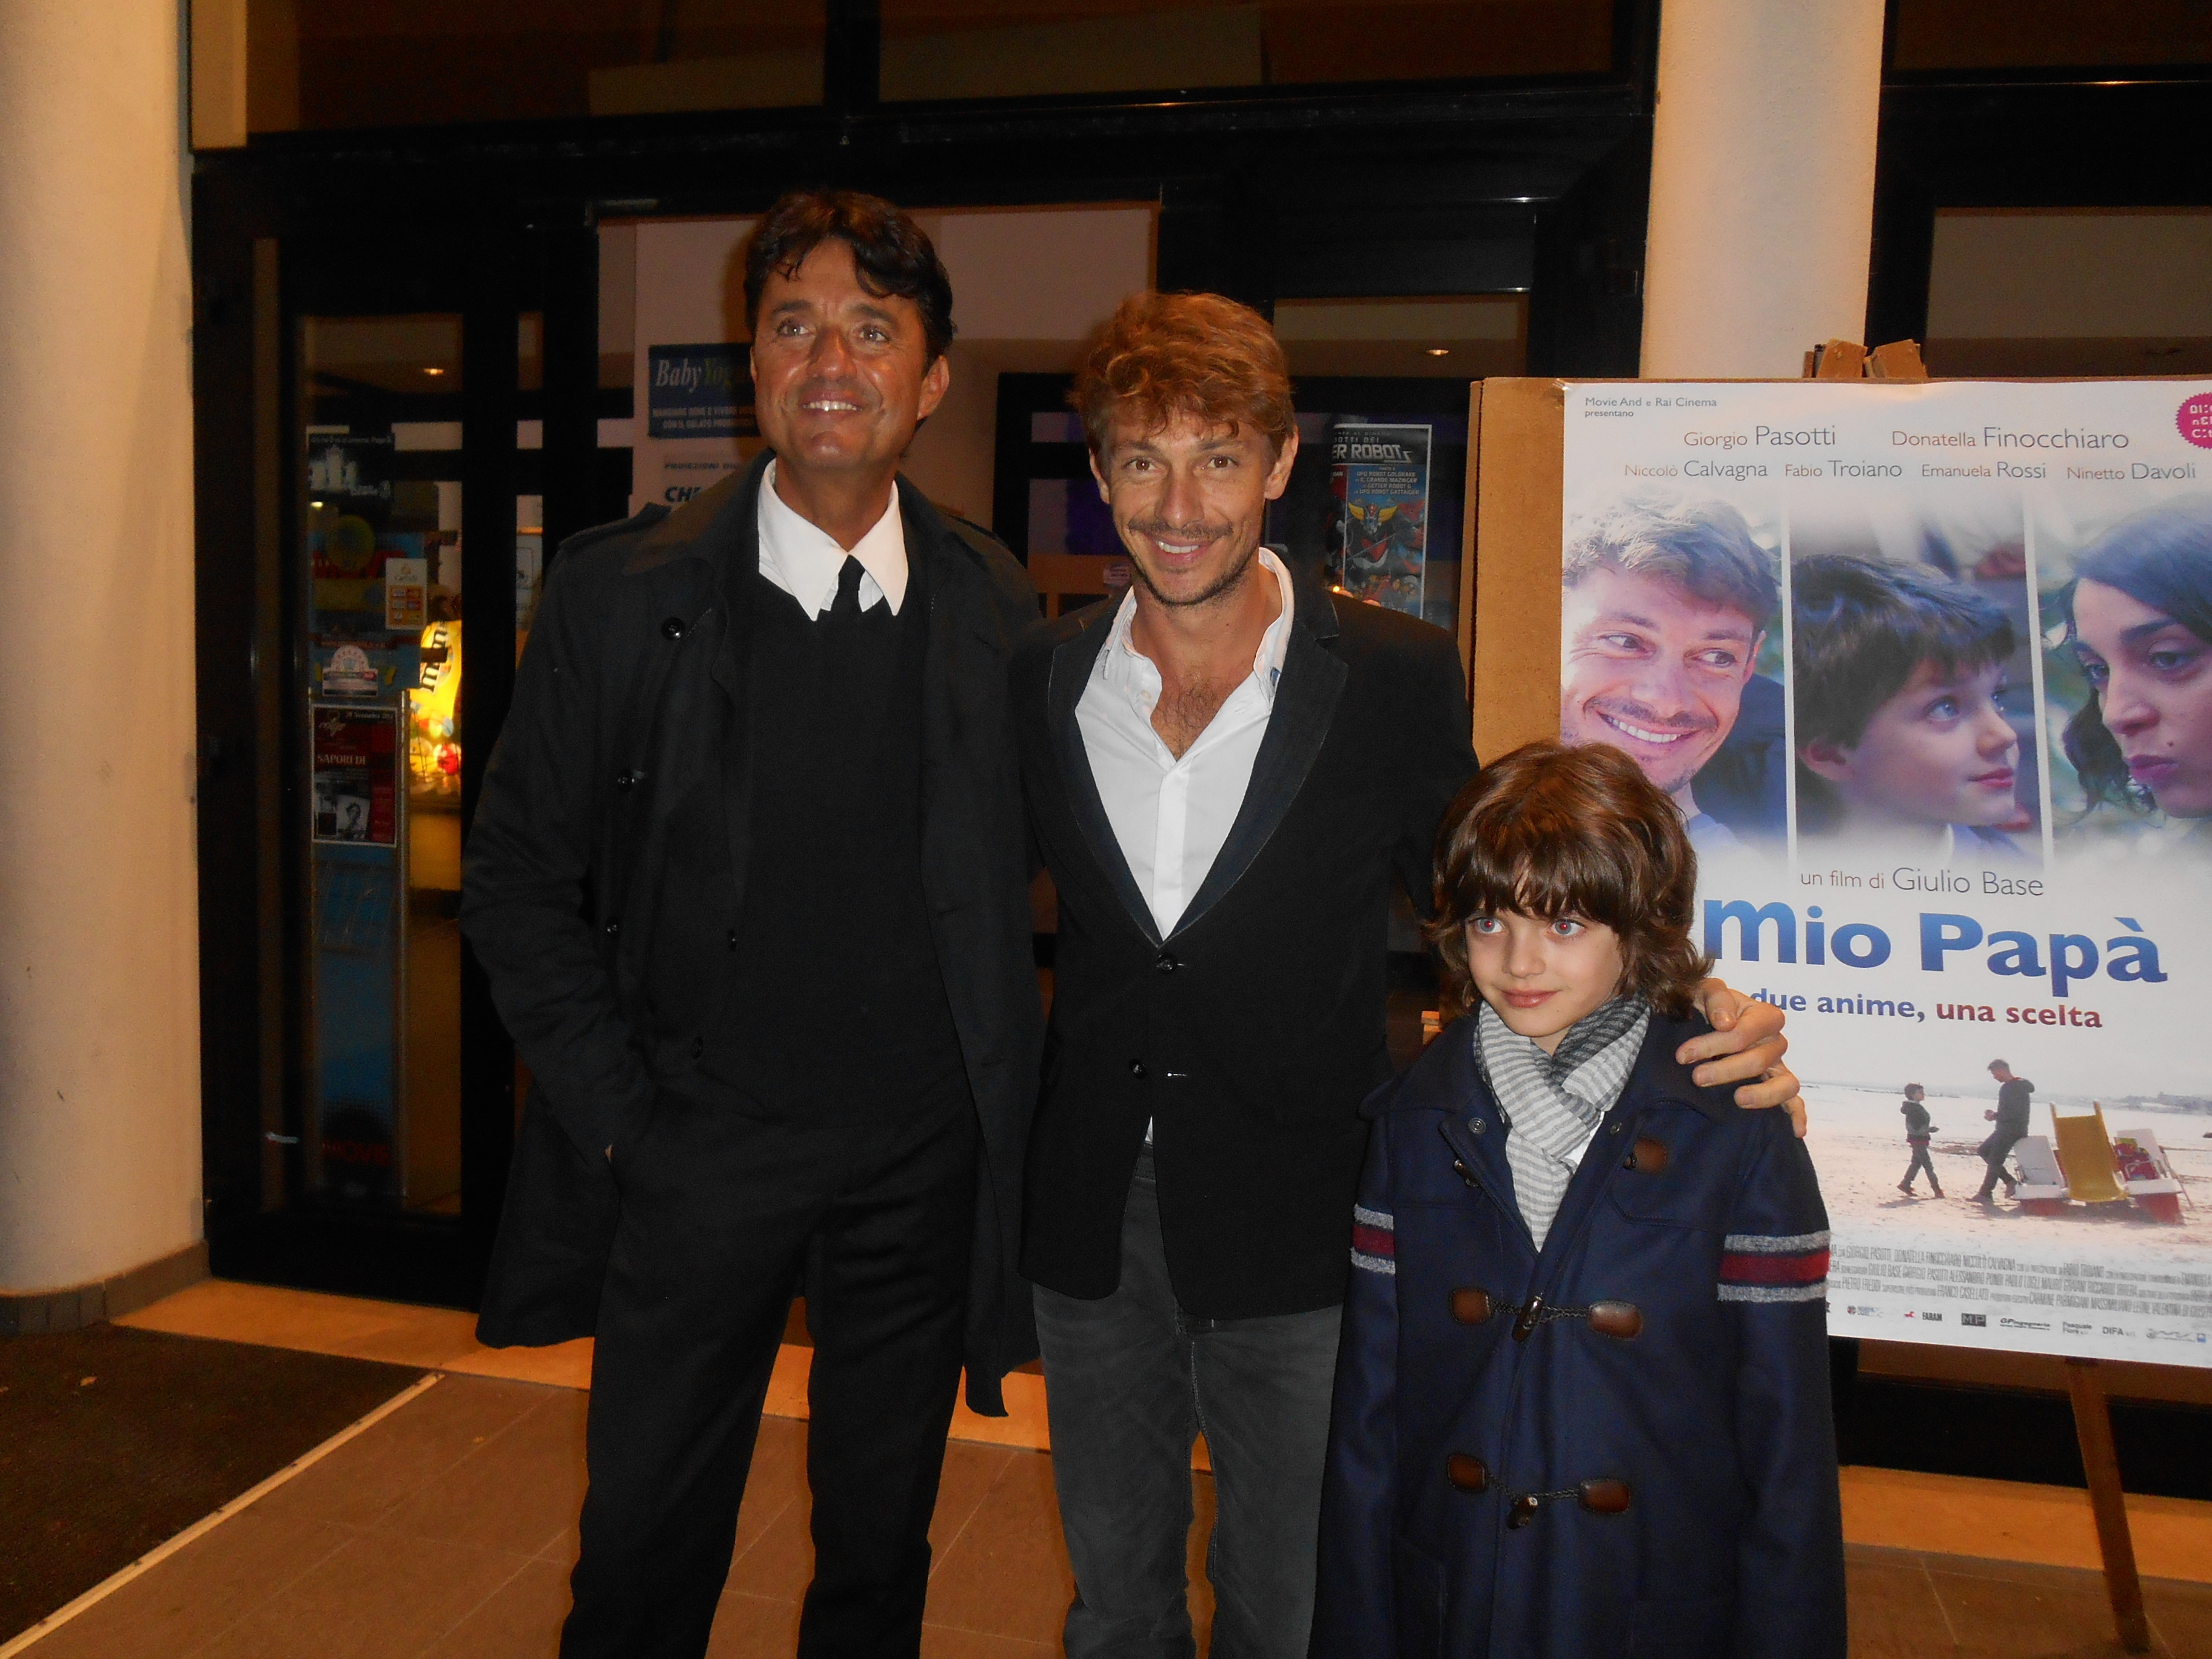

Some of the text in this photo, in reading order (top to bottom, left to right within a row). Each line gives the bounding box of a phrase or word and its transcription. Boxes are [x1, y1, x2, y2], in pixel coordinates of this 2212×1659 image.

[657, 358, 702, 393] Baby
[1585, 397, 1617, 407] Movie
[1620, 397, 1641, 407] And
[1655, 397, 1672, 407] Rai
[1675, 397, 1717, 407] Cinema
[1684, 425, 1837, 449] Giorgio Pasotti
[1891, 426, 2130, 451] Donatella Finocchiaro
[1350, 443, 1402, 460] ROBOT
[1624, 459, 2196, 482] Niccolò Calvagna Fabio Troiano Emanuela Rossi Ninetto Davoli
[1800, 866, 2044, 897] un film di Giulio Base
[1919, 912, 2168, 998] Papà
[1817, 993, 1926, 1023] anime,
[1936, 1003, 1996, 1023] una
[2006, 1005, 2103, 1028] scelta
[1846, 1245, 1869, 1260] GIORGIO
[1870, 1247, 1891, 1261] PASOTTI
[1894, 1248, 1925, 1264] DONATELLA
[1868, 1262, 1887, 1277] GIULIO
[1888, 1264, 1902, 1278] BASE
[1842, 1276, 1861, 1290] PIETRO
[1937, 1284, 1959, 1299] FRANCO
[2102, 1326, 2124, 1336] DIFA
